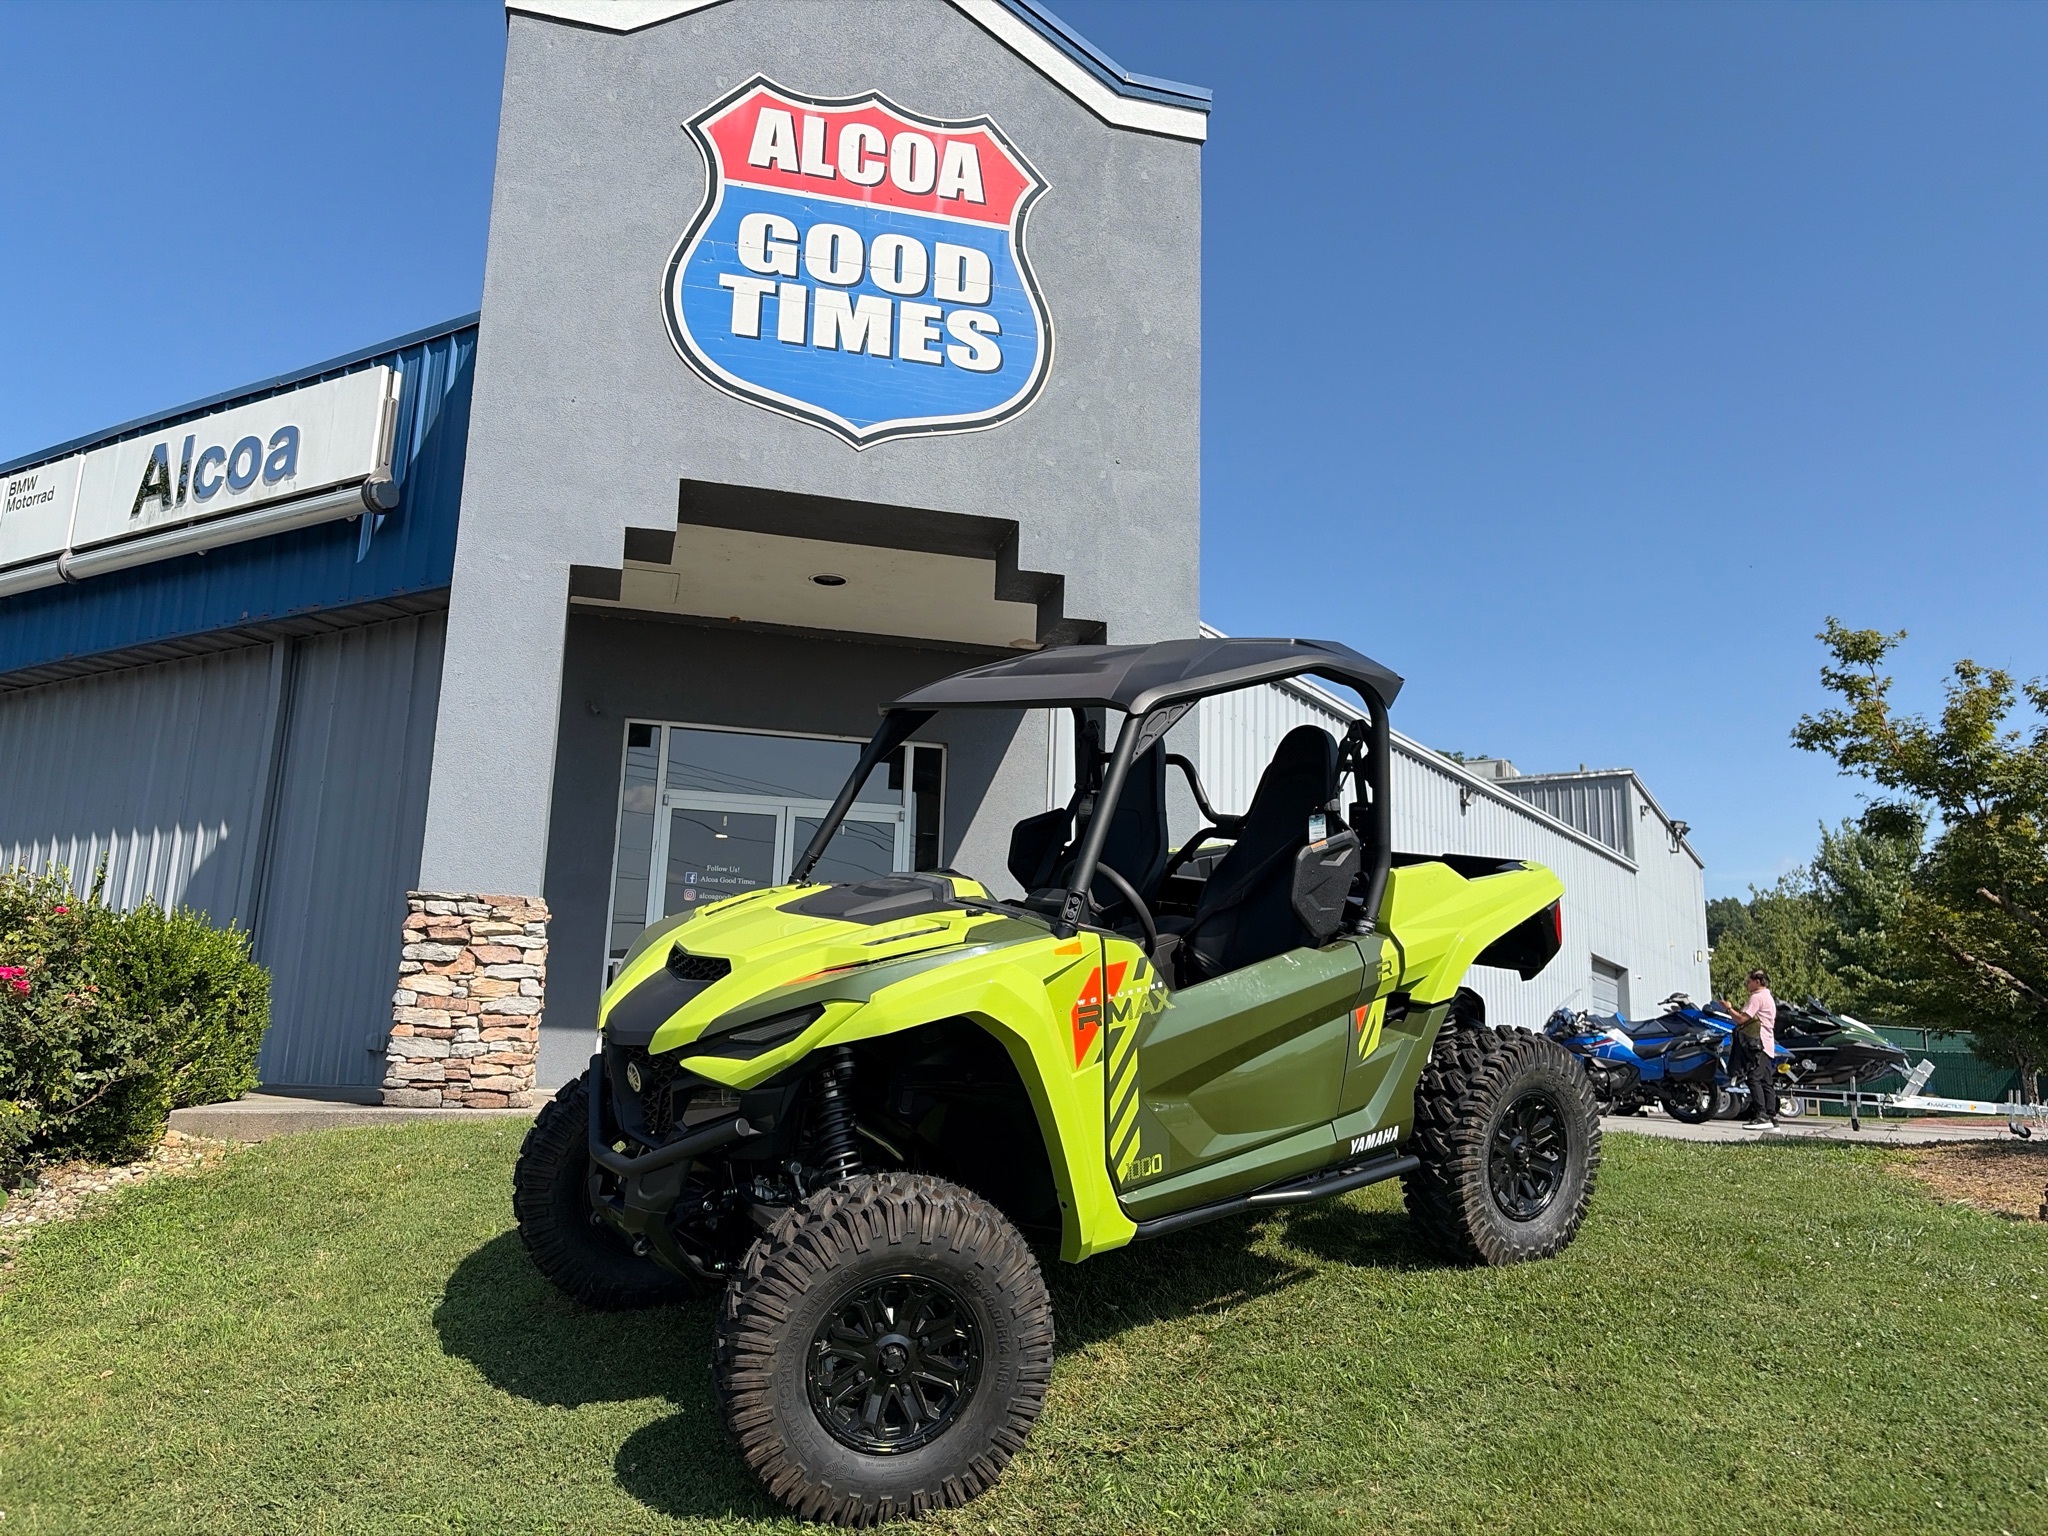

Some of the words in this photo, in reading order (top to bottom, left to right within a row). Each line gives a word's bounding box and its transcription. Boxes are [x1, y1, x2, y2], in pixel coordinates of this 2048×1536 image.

[747, 106, 986, 205] ALCOA
[737, 212, 993, 306] GOOD
[718, 272, 1003, 374] TIMES
[8, 475, 39, 497] BMW
[129, 425, 301, 521] Alcoa
[5, 485, 55, 514] Motorrad
[706, 865, 727, 873] Follow
[719, 876, 736, 884] Good
[738, 877, 756, 885] Times
[1350, 1125, 1400, 1155] YAMAHA
[1125, 1153, 1163, 1181] 1000
